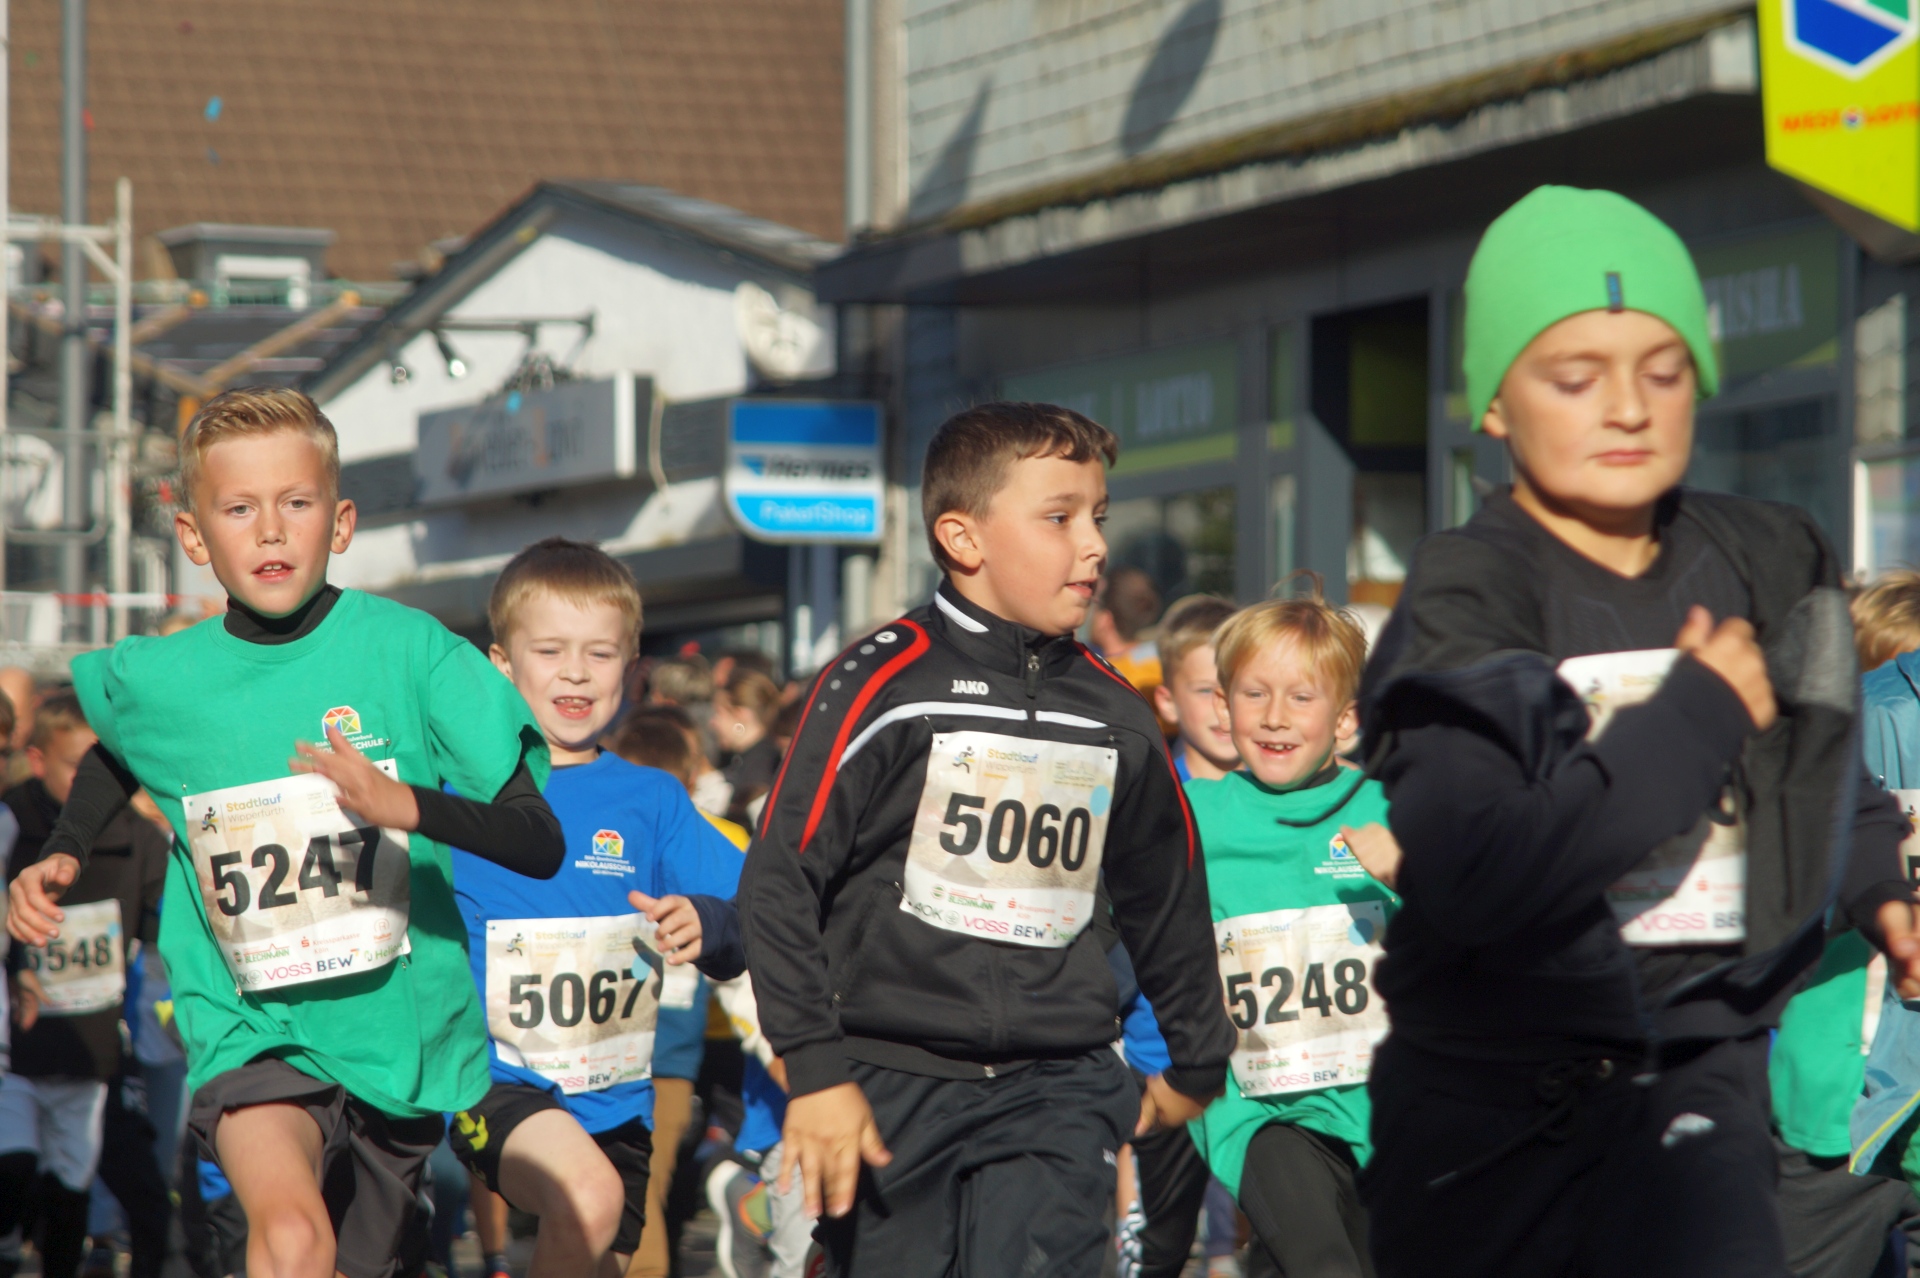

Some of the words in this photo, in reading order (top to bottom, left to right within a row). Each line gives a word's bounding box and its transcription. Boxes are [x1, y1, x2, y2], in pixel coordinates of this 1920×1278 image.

[766, 455, 871, 480] Hermes
[951, 679, 989, 695] JAKO
[226, 793, 281, 813] Stadtlauf
[939, 792, 1090, 871] 5060
[210, 825, 381, 916] 5247
[963, 915, 1010, 935] VOSS
[1013, 924, 1046, 940] BEW
[1242, 923, 1290, 937] Stadtlauf
[1636, 912, 1708, 931] VOSS
[535, 930, 587, 940] Stadtlauf
[264, 962, 312, 981] VOSS
[316, 954, 354, 972] BEW
[509, 968, 648, 1029] 5067
[1226, 958, 1368, 1030] 5248
[588, 1073, 612, 1086] BEW
[1268, 1073, 1310, 1087] VOSS
[1313, 1070, 1339, 1083] BEW
